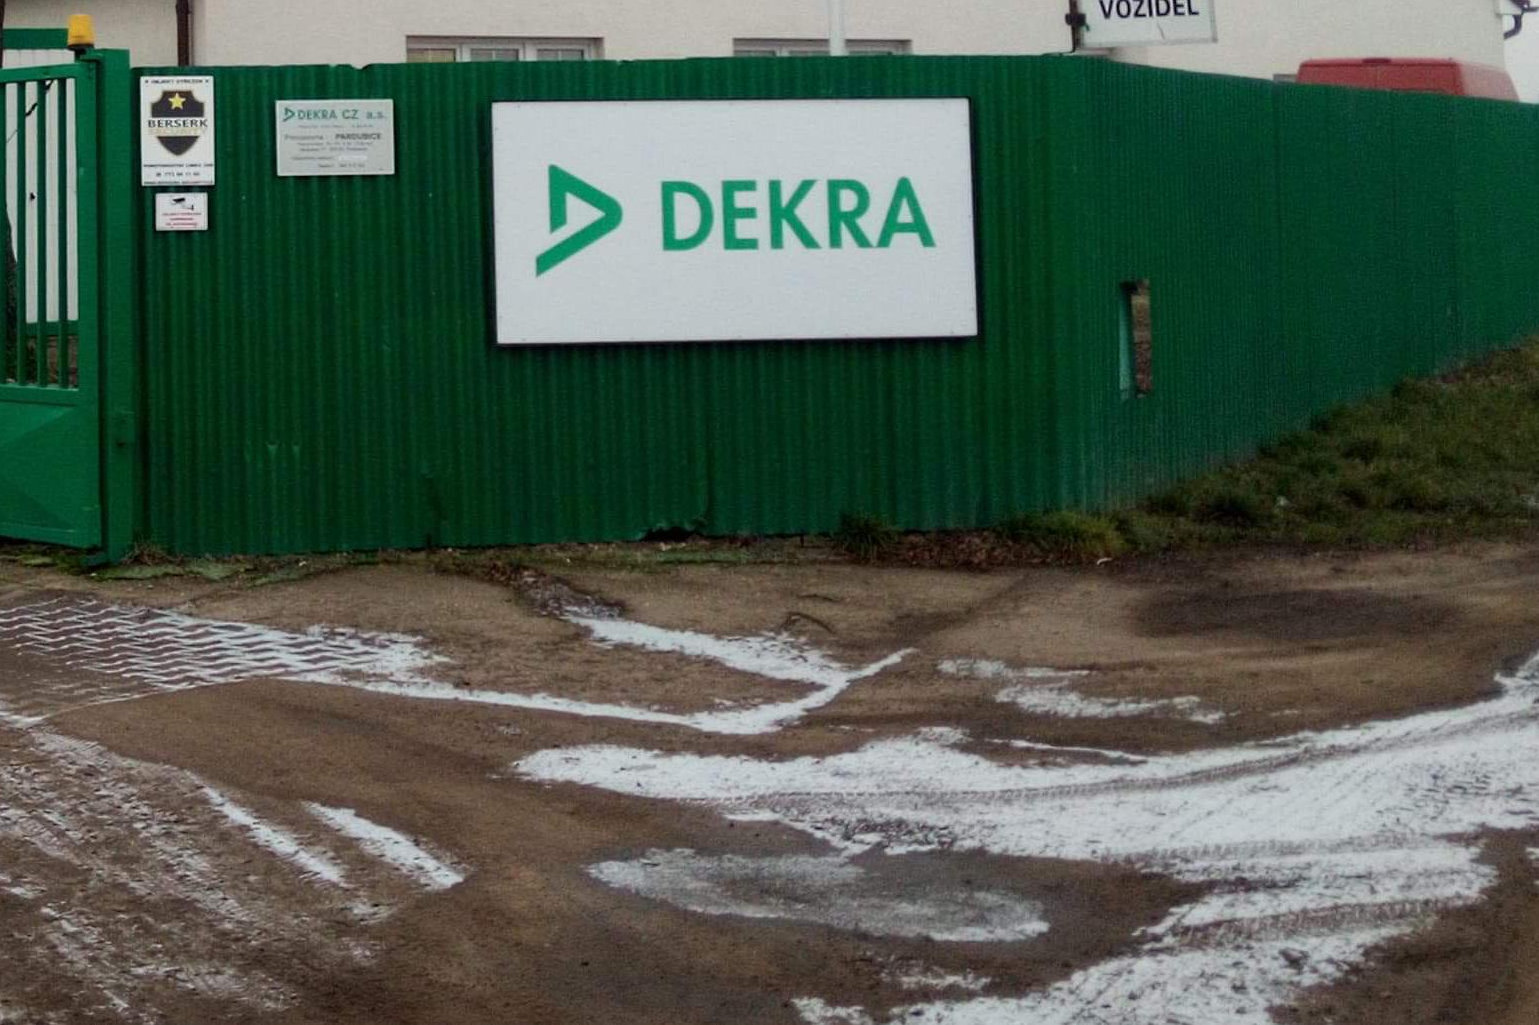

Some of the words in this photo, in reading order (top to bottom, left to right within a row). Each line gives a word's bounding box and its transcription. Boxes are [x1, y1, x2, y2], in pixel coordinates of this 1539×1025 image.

[297, 109, 338, 120] DEKRA
[342, 108, 359, 120] CZ
[148, 118, 209, 128] BERSERK
[661, 176, 936, 251] DEKRA
